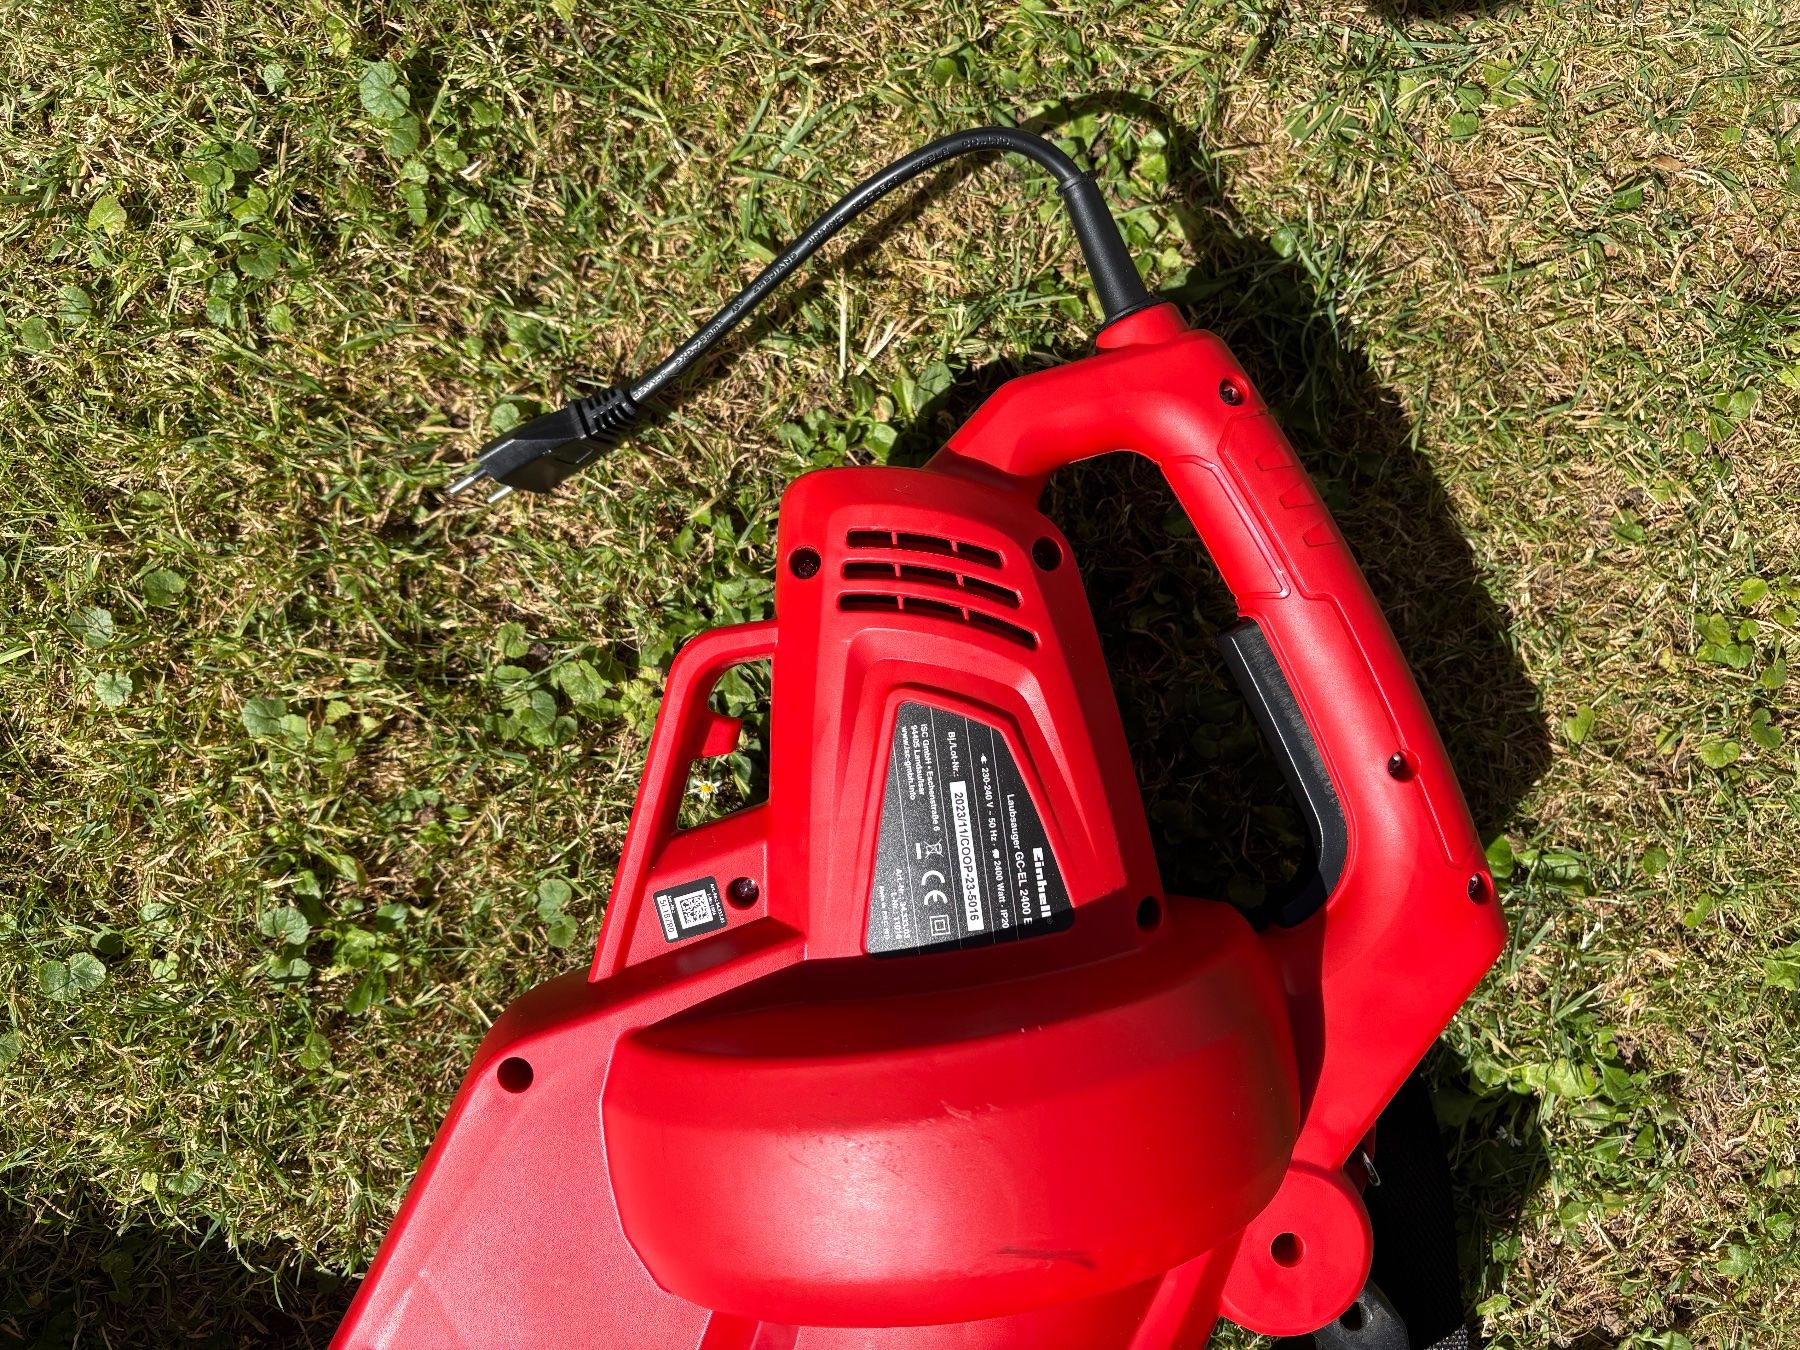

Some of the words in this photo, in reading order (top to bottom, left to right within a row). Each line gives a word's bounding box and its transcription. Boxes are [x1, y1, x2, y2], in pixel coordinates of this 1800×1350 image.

[910, 724, 919, 748] 94405
[919, 723, 927, 737] ISC
[900, 726, 915, 800] www.isc-gmbh.info
[922, 740, 931, 764] GmbH
[913, 749, 925, 795] Landau/Isar
[981, 767, 992, 800] 230-240
[926, 771, 939, 824] Eschenstraße
[947, 731, 960, 777] Bj./Lot-Nr.:
[955, 792, 979, 921] 2023/11/COOP-23-5016
[988, 817, 996, 828] 50
[1006, 794, 1021, 849] Laubsauger
[989, 829, 998, 841] Hz
[993, 860, 1003, 880] 2400
[1014, 851, 1027, 886] GC-EL
[996, 883, 1005, 902] Watt
[1032, 847, 1051, 917] Einhell
[1019, 888, 1031, 914] 2400
[999, 909, 1009, 928] IP20
[1023, 917, 1032, 925] E
